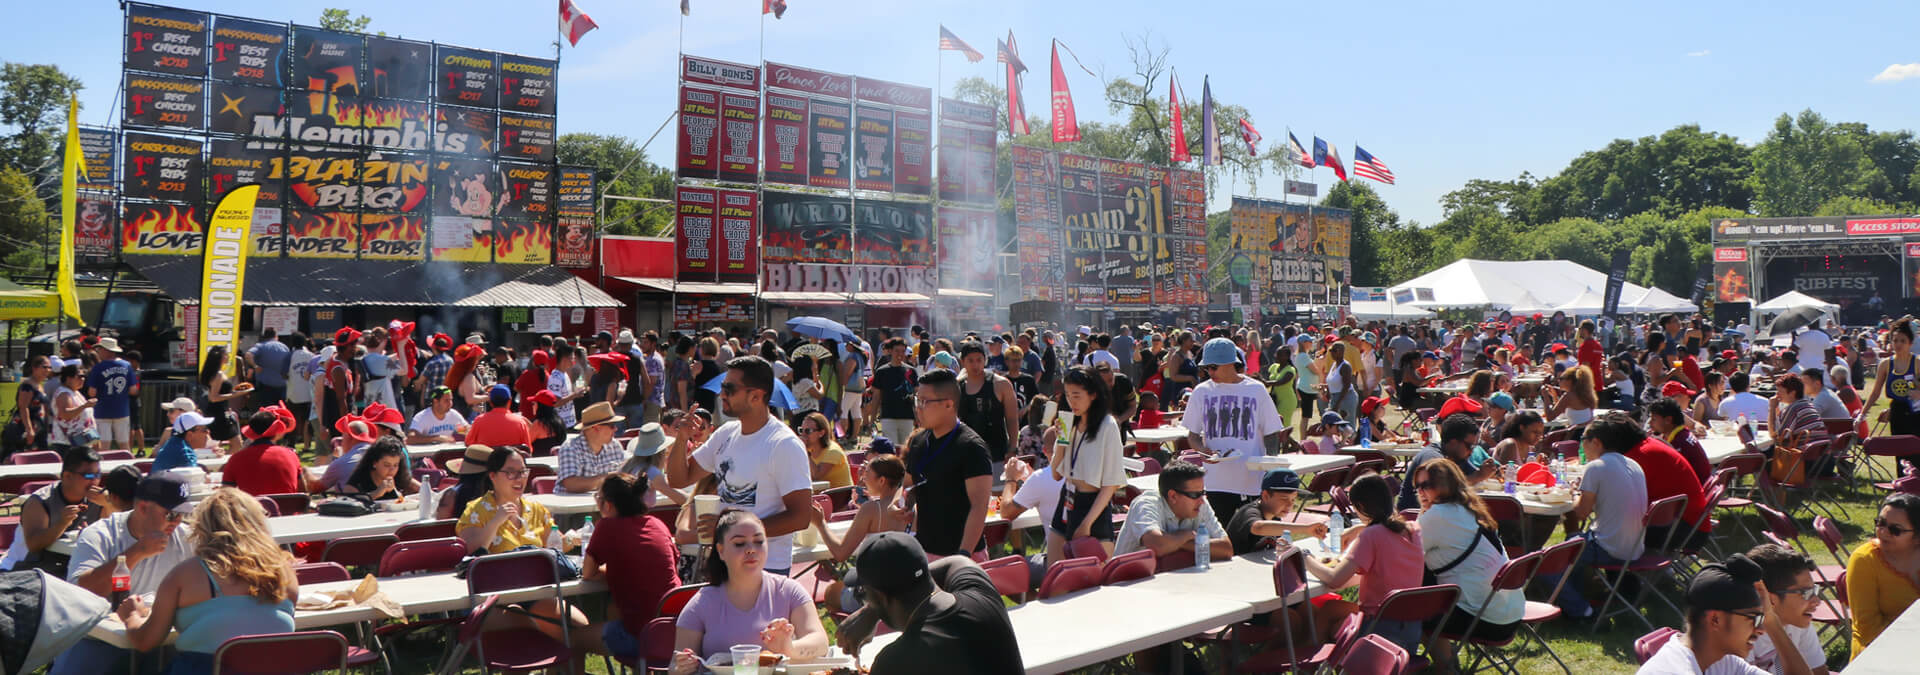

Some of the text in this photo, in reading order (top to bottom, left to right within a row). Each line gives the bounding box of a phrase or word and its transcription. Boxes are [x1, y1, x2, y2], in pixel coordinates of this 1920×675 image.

[163, 32, 191, 43] BEST
[152, 42, 201, 56] CHICKEN
[240, 45, 269, 56] BEST
[240, 56, 267, 68] RIBS
[688, 61, 754, 81] BILLY BONES
[164, 93, 188, 102] BEST
[154, 101, 197, 112] CHICKEN
[687, 126, 713, 136] CHOICE
[728, 130, 752, 140] CHOICE
[246, 115, 469, 160] Memphis
[691, 136, 709, 145] BEST
[161, 157, 190, 168] BEST
[160, 168, 188, 180] RIBS
[508, 168, 549, 180] CALGARY
[1127, 166, 1168, 180] FINEST
[317, 184, 402, 208] BBQ
[684, 217, 712, 228] JUDGE'S
[1125, 186, 1169, 261] 31
[1851, 223, 1888, 233] ACCESS
[685, 228, 711, 238] CHOICE
[725, 229, 750, 240] CHOICE
[1065, 209, 1125, 252] CAMP
[137, 231, 203, 250] LOVE
[369, 239, 422, 256] RIBS!
[689, 238, 706, 248] BEST
[728, 240, 745, 249] BEST
[687, 248, 709, 258] SAUCE
[767, 264, 938, 293] BILLY BONES
[1792, 276, 1880, 291] RIBFEST
[105, 376, 127, 395] 19
